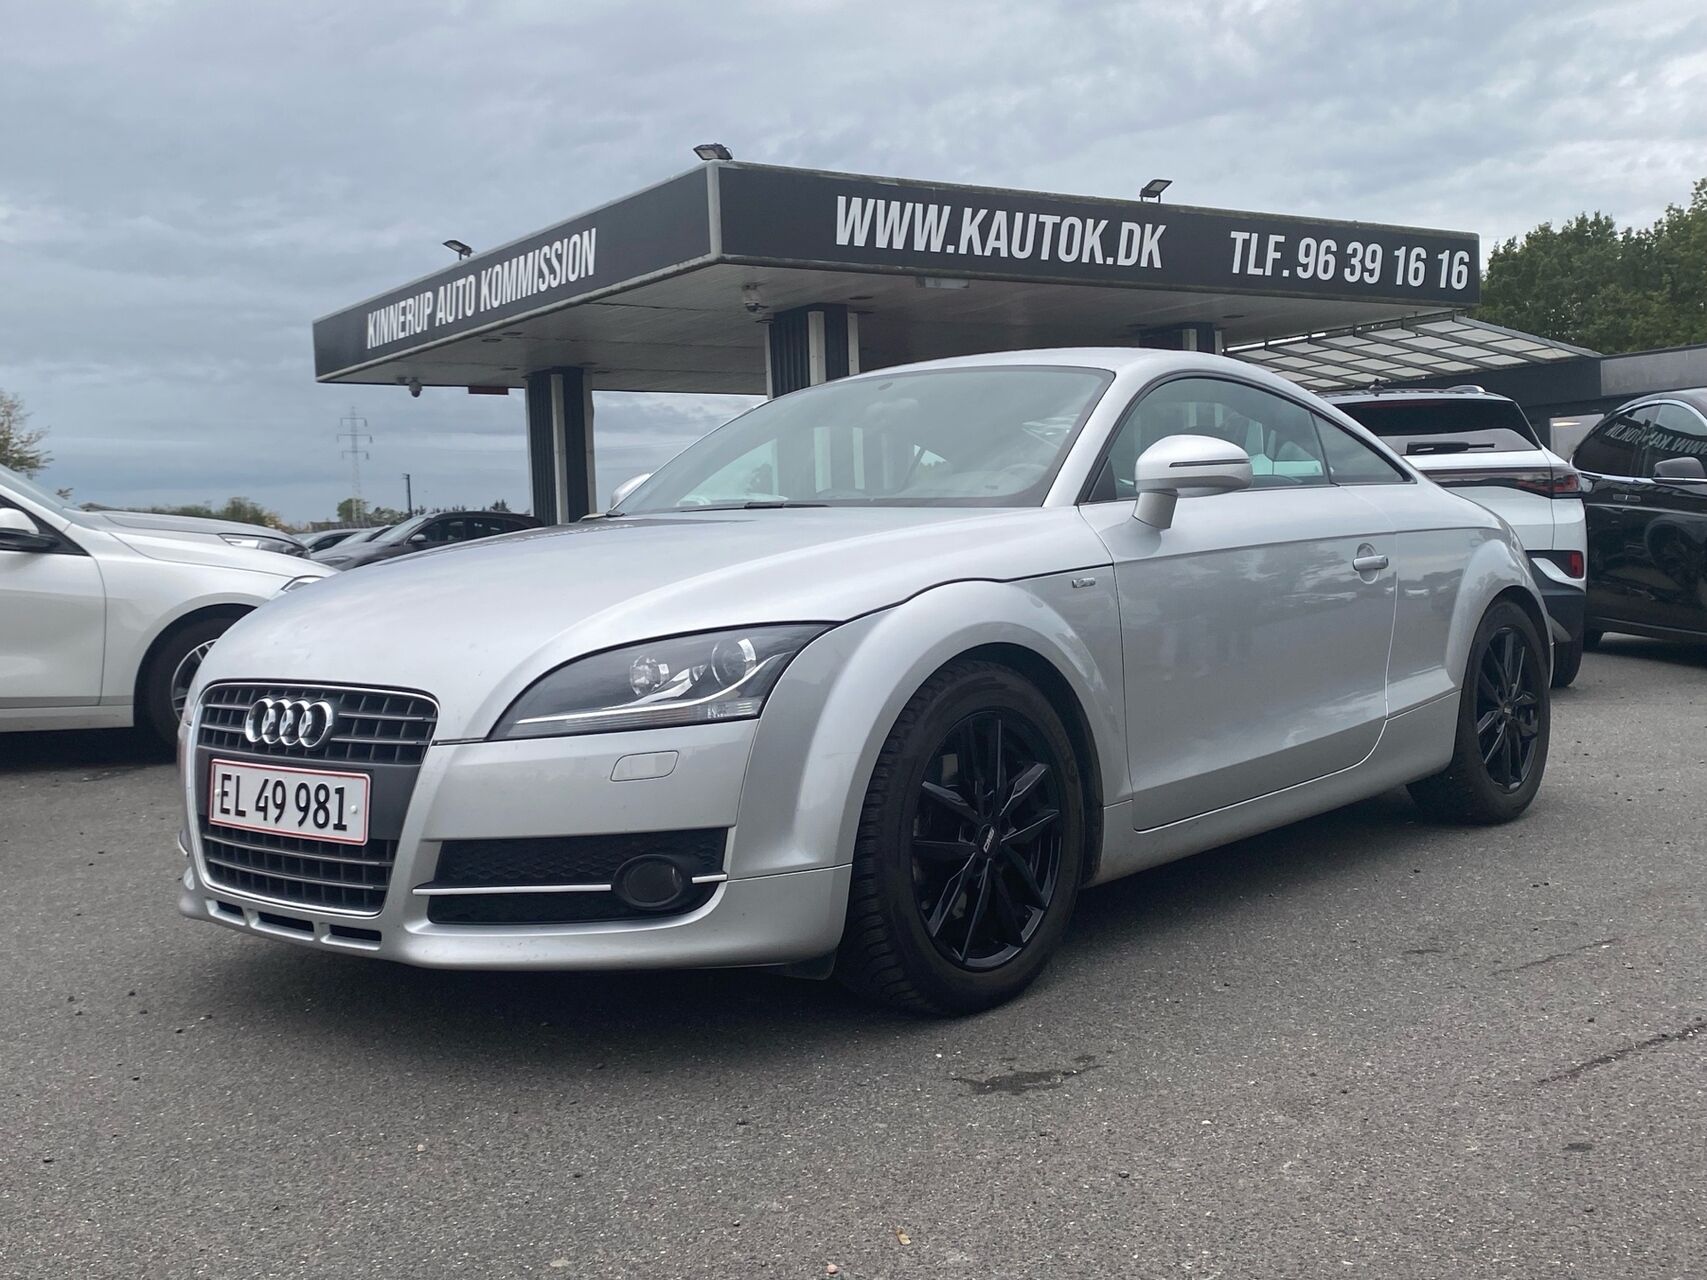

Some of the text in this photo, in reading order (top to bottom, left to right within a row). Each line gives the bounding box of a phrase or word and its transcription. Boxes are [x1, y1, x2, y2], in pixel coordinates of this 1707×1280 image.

[836, 195, 1167, 269] WWW.KAUTOK.DK
[1230, 231, 1470, 290] TLF. 96 39 16 16
[367, 227, 597, 350] KINNERUP AUTO KOMMISSION
[219, 773, 348, 832] EL 49 981
